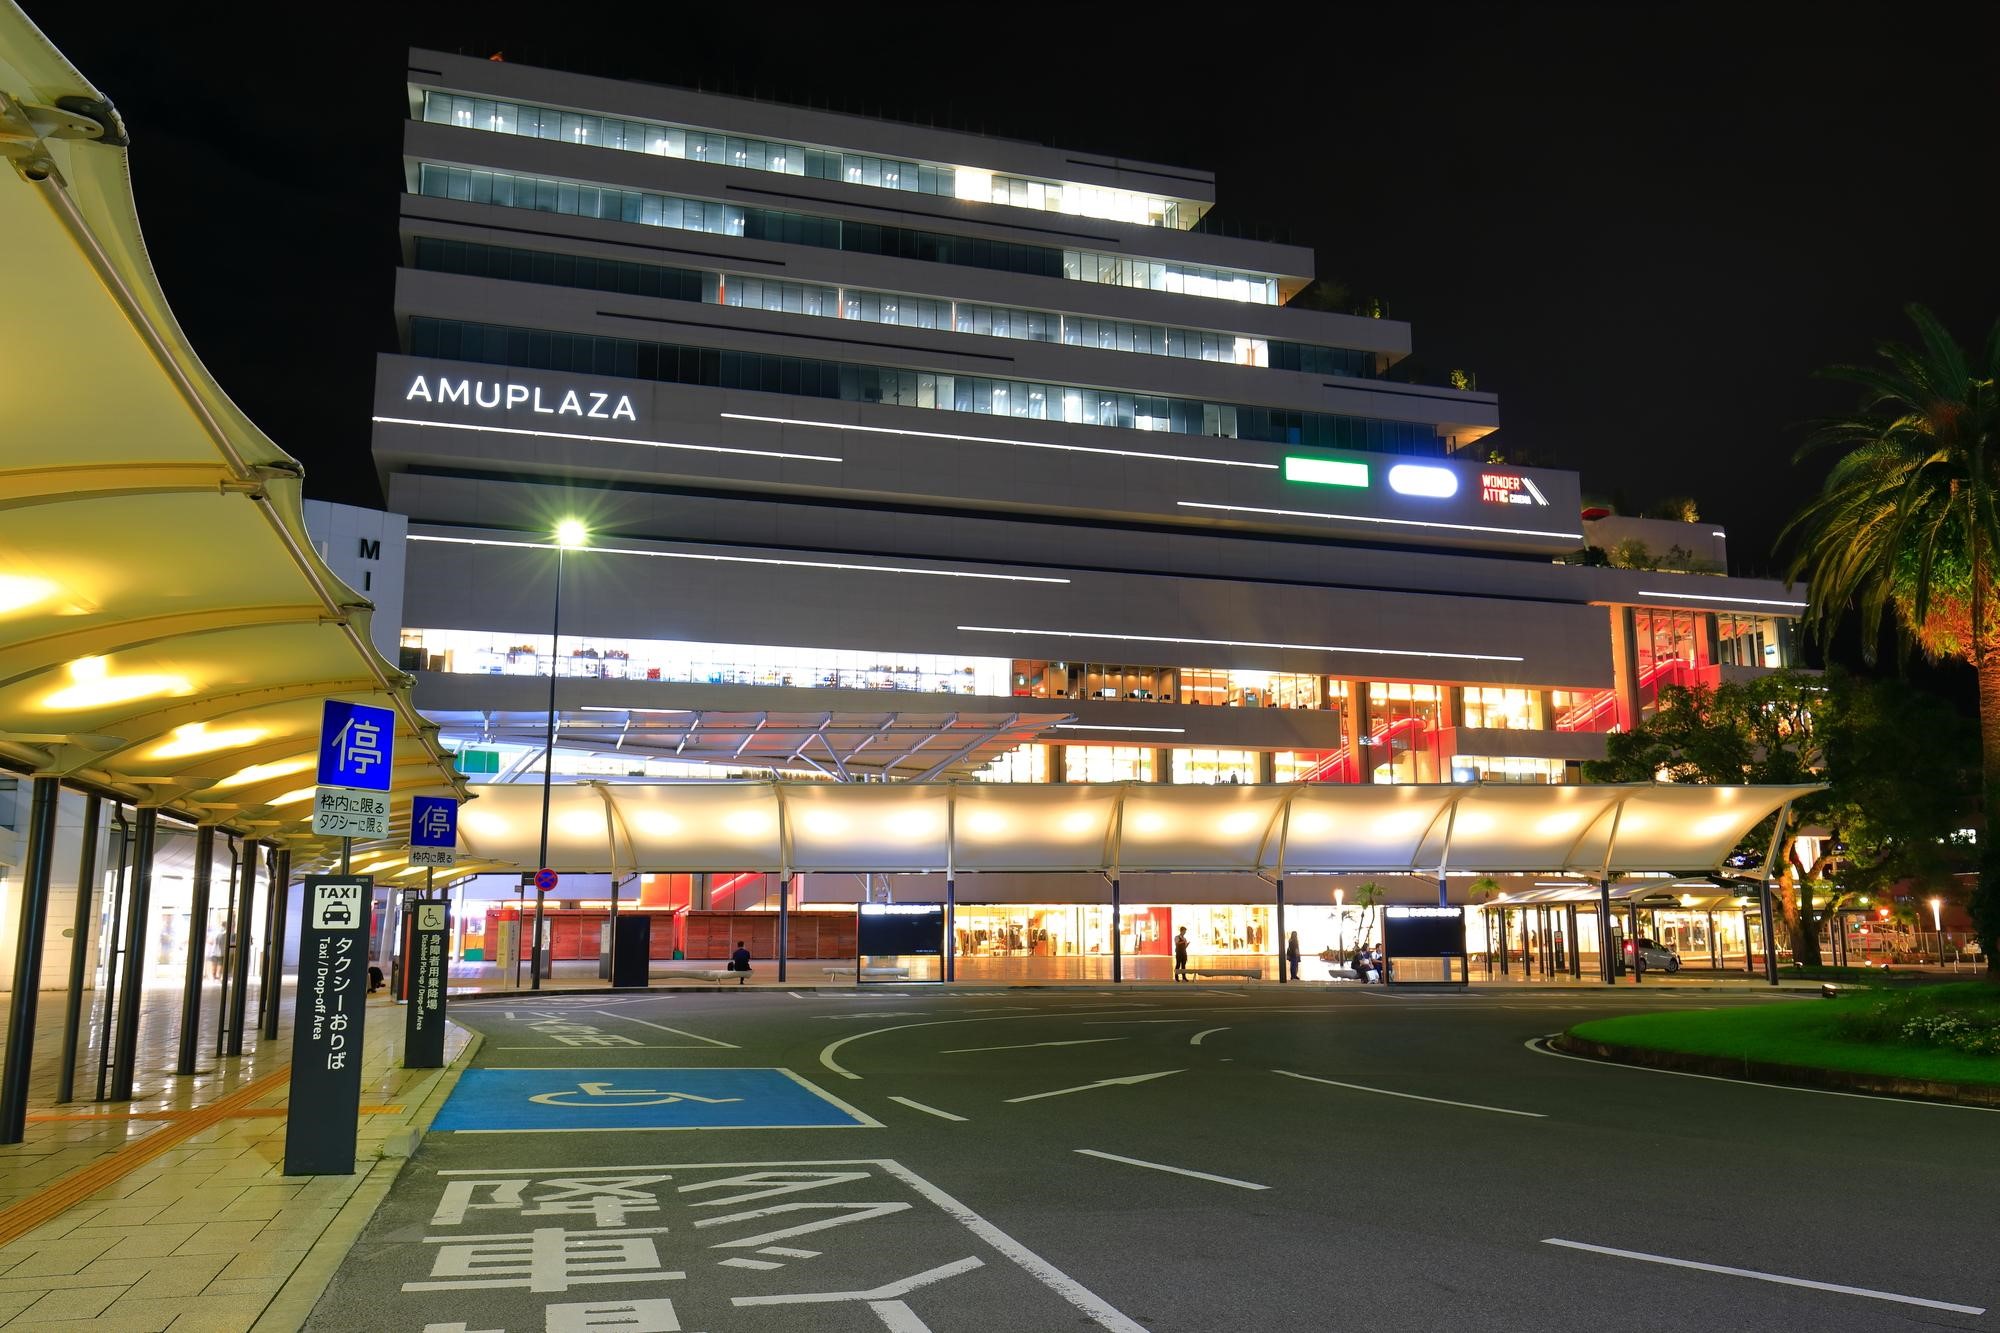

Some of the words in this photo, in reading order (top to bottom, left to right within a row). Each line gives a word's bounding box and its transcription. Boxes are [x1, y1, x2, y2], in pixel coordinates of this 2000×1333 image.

[406, 375, 636, 421] AMUPLAZA
[1481, 474, 1520, 490] WONDER
[1483, 488, 1508, 503] ATTIC
[331, 717, 382, 775] 停
[320, 794, 385, 815] 枠内に限る
[319, 814, 384, 833] タクシーに限る
[418, 804, 450, 839] 停
[412, 851, 453, 864] 枠内に限る
[319, 887, 357, 899] TAXI
[318, 937, 331, 959] Taxi
[420, 934, 429, 961] Disabled
[313, 967, 329, 1013] Drop-off
[327, 937, 353, 1070] タクシーおりば
[312, 1015, 325, 1040] Area
[416, 1016, 424, 1031] Area
